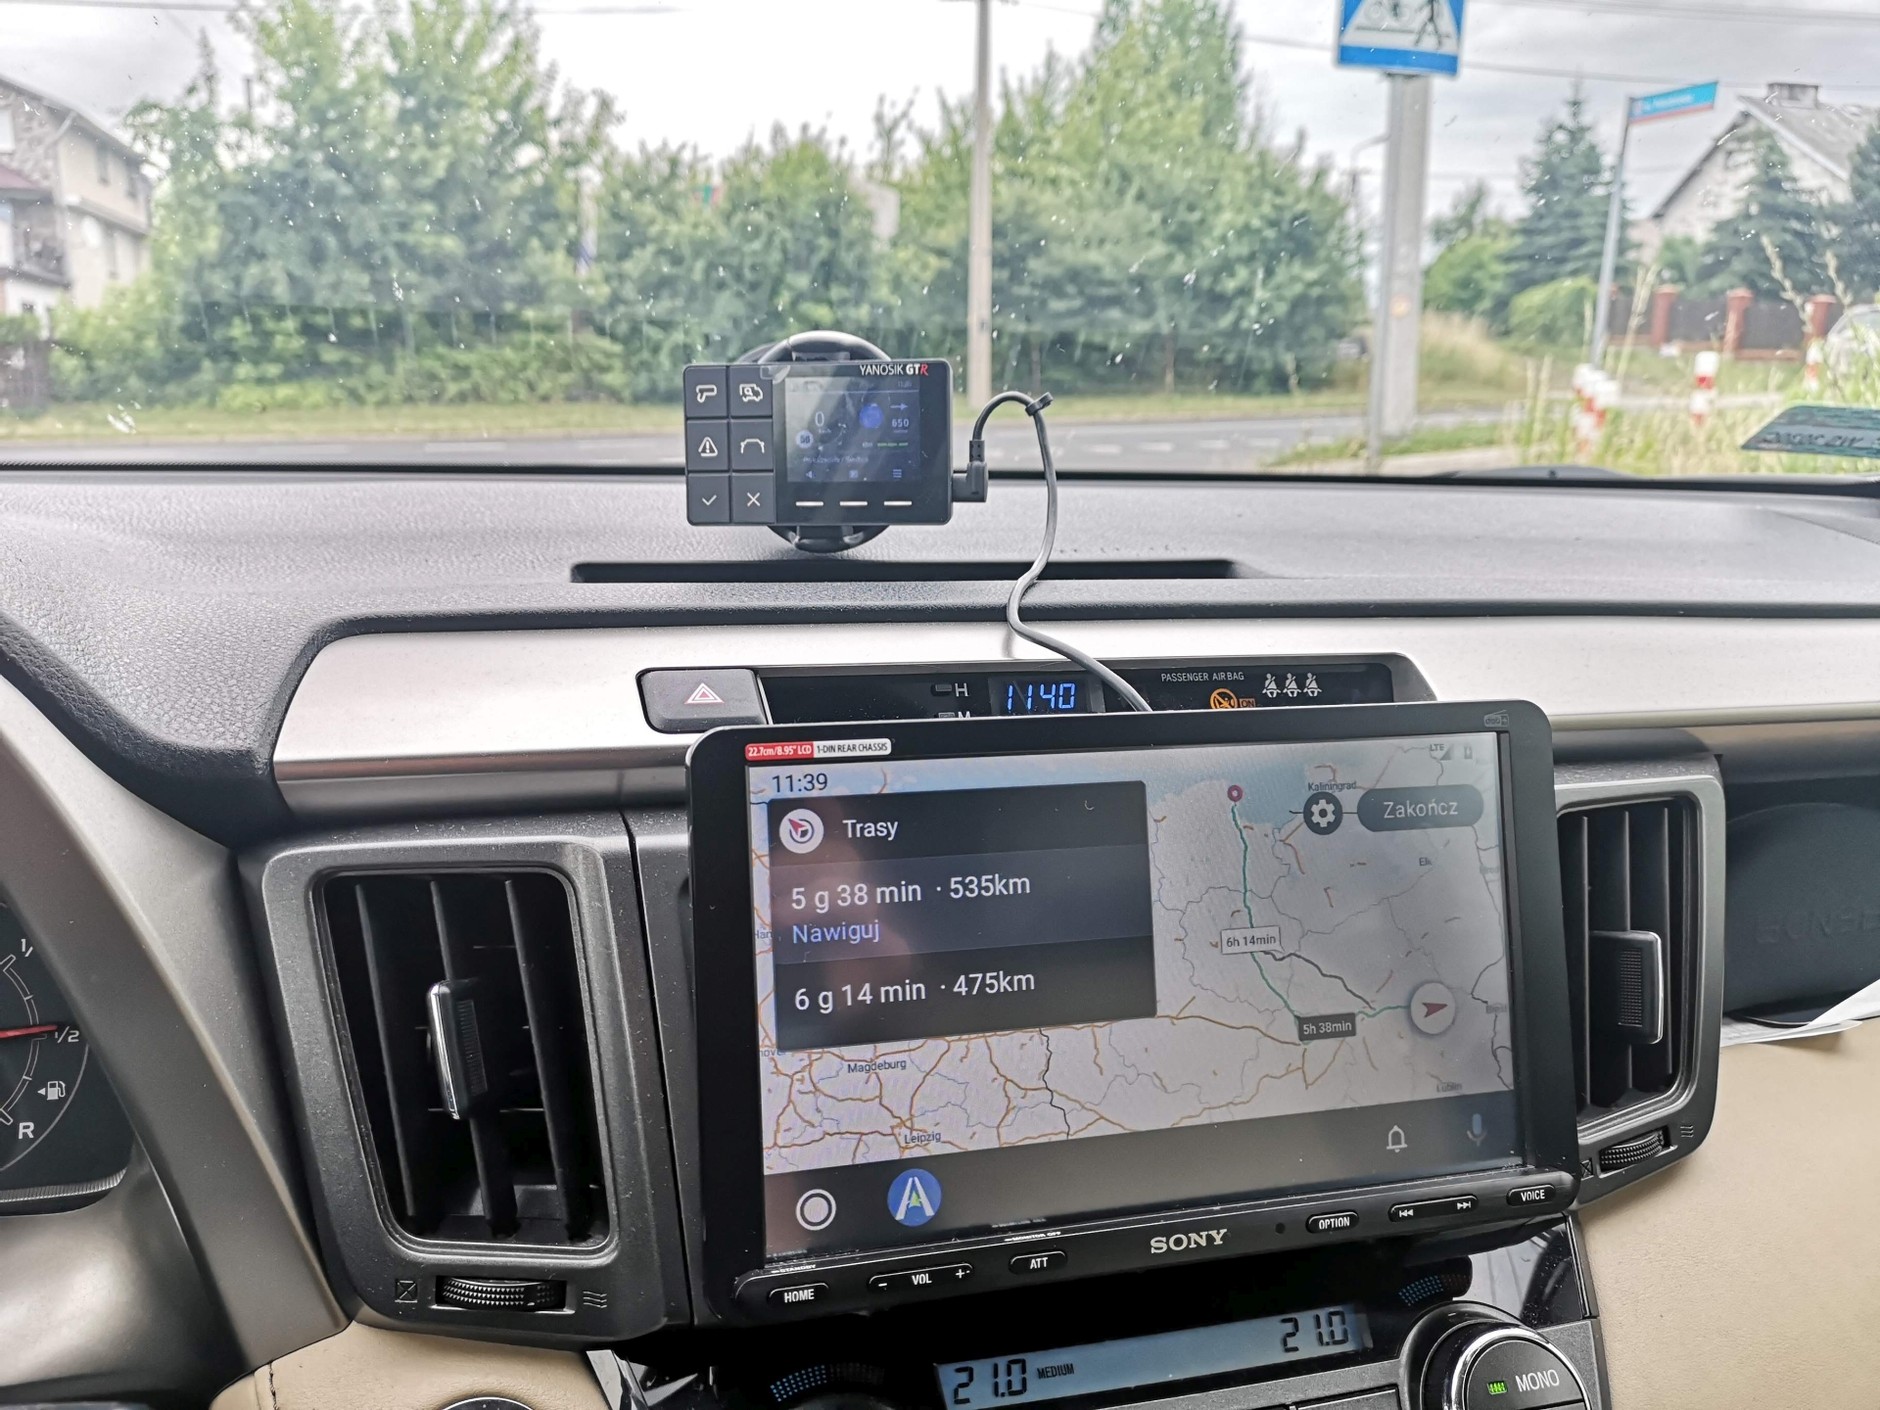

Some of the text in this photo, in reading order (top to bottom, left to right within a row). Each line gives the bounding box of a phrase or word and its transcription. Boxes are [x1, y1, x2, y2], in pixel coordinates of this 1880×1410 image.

[860, 362, 929, 376] YANOSIK GTR
[891, 418, 910, 428] 650
[1161, 671, 1245, 682] PASSENGER AIRBAG
[954, 682, 970, 698] H
[797, 744, 813, 755] LCD
[817, 742, 888, 754] 1-DIN REAR CHASSIS
[1429, 743, 1445, 752] LTE
[772, 772, 828, 794] 11:39
[1308, 780, 1357, 793] Kaliningrad
[1383, 799, 1459, 819] Zakończ
[842, 819, 899, 842] Trasy
[791, 873, 1031, 914] 5 g 38 min 535km
[792, 919, 880, 944] Nawiguj
[20, 938, 34, 958] 1/
[1226, 933, 1277, 948] 6h 14min
[795, 970, 1035, 1014] 6 g 14 min 475km
[1303, 1021, 1352, 1035] 5h 38min
[847, 1058, 907, 1074] Magdeburg
[18, 1121, 35, 1139] R
[904, 1130, 941, 1146] Leipzig
[1521, 1189, 1546, 1202] VOICE
[1318, 1215, 1351, 1230] OPTION
[1150, 1228, 1229, 1255] SONY
[1029, 1256, 1048, 1270] ATT
[911, 1273, 932, 1286] VOL
[783, 1287, 815, 1302] HOME
[1280, 1310, 1350, 1353] 21.0
[953, 1357, 1075, 1405] 21.0 MEDIUM
[1515, 1369, 1560, 1393] MONO
